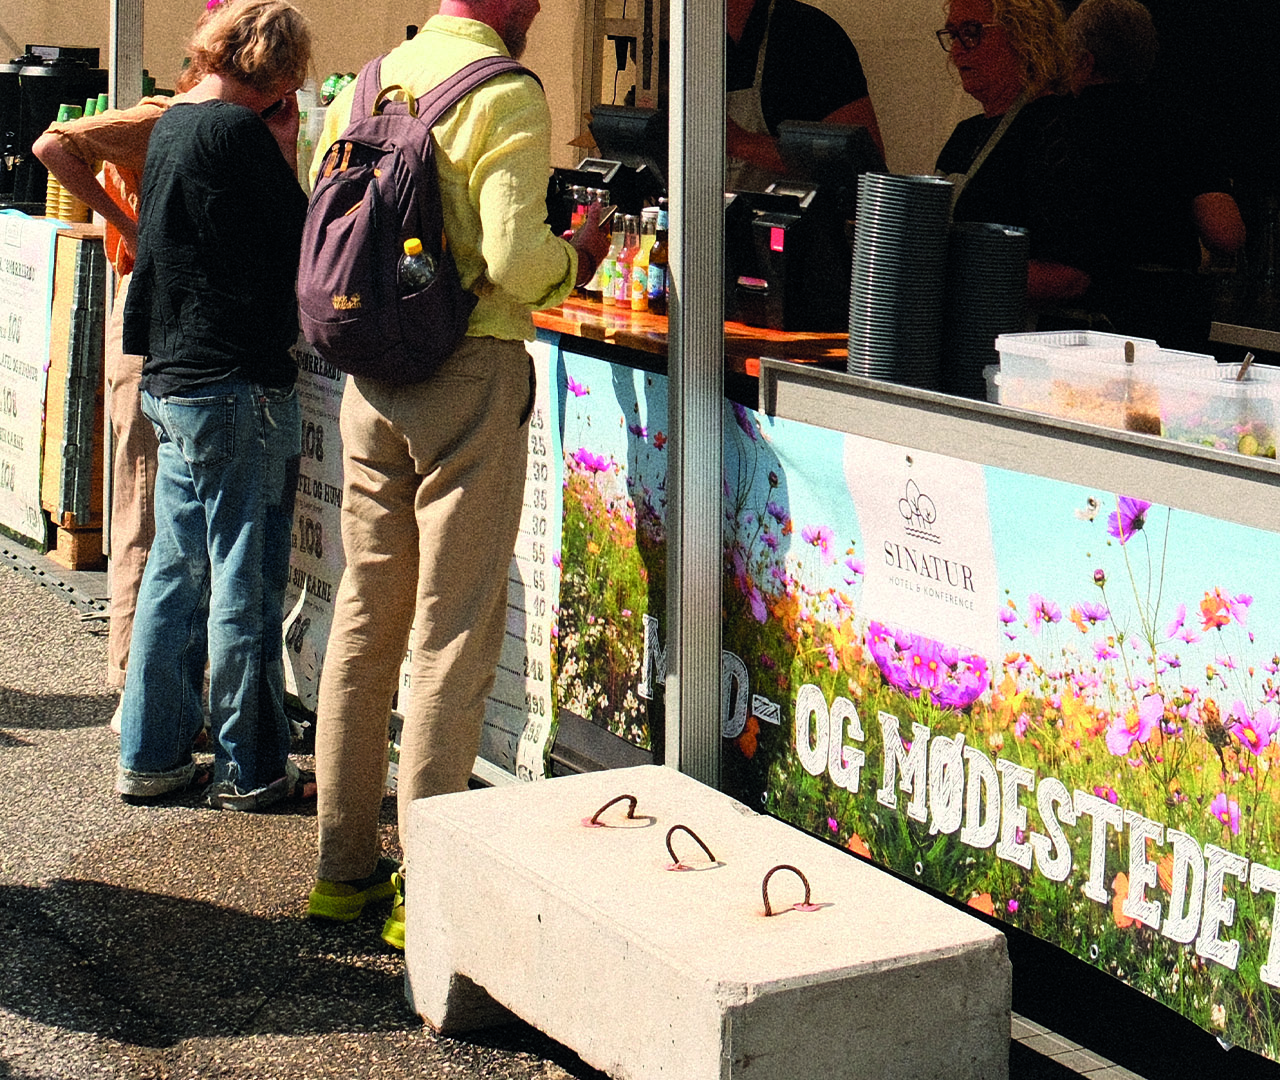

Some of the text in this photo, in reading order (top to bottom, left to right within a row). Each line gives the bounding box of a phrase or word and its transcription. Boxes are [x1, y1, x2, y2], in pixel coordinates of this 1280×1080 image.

[531, 434, 546, 457] 25
[533, 461, 548, 482] 30
[533, 488, 548, 511] 35
[532, 515, 547, 537] 30
[532, 541, 546, 565] 55
[884, 540, 976, 593] SINATUR
[889, 575, 913, 591] HOTEL
[923, 586, 974, 611] KONFERENCE
[530, 622, 544, 647] 55
[794, 682, 866, 794] OG
